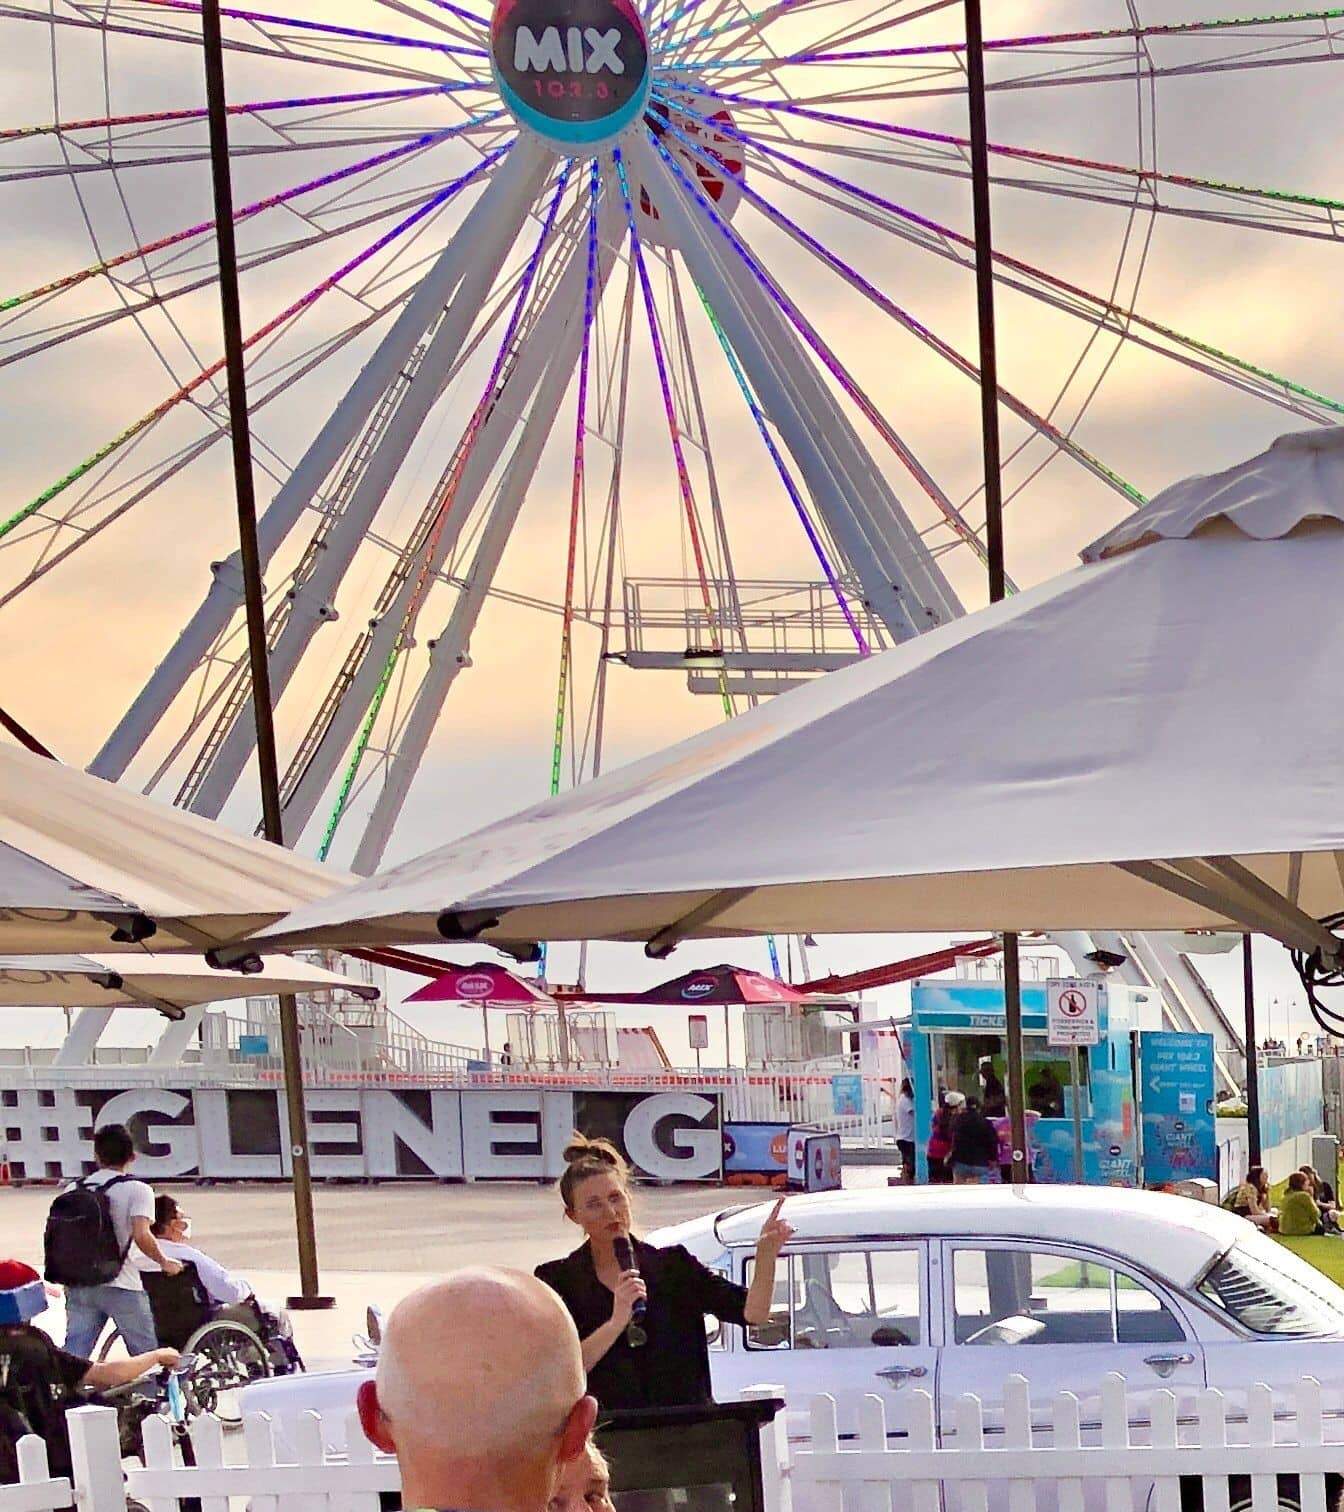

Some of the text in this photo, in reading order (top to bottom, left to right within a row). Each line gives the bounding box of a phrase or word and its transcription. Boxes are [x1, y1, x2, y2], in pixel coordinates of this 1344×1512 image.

[514, 25, 624, 75] MIX
[969, 1015, 1005, 1027] TICKE
[0, 1088, 720, 1179] #GLENELG
